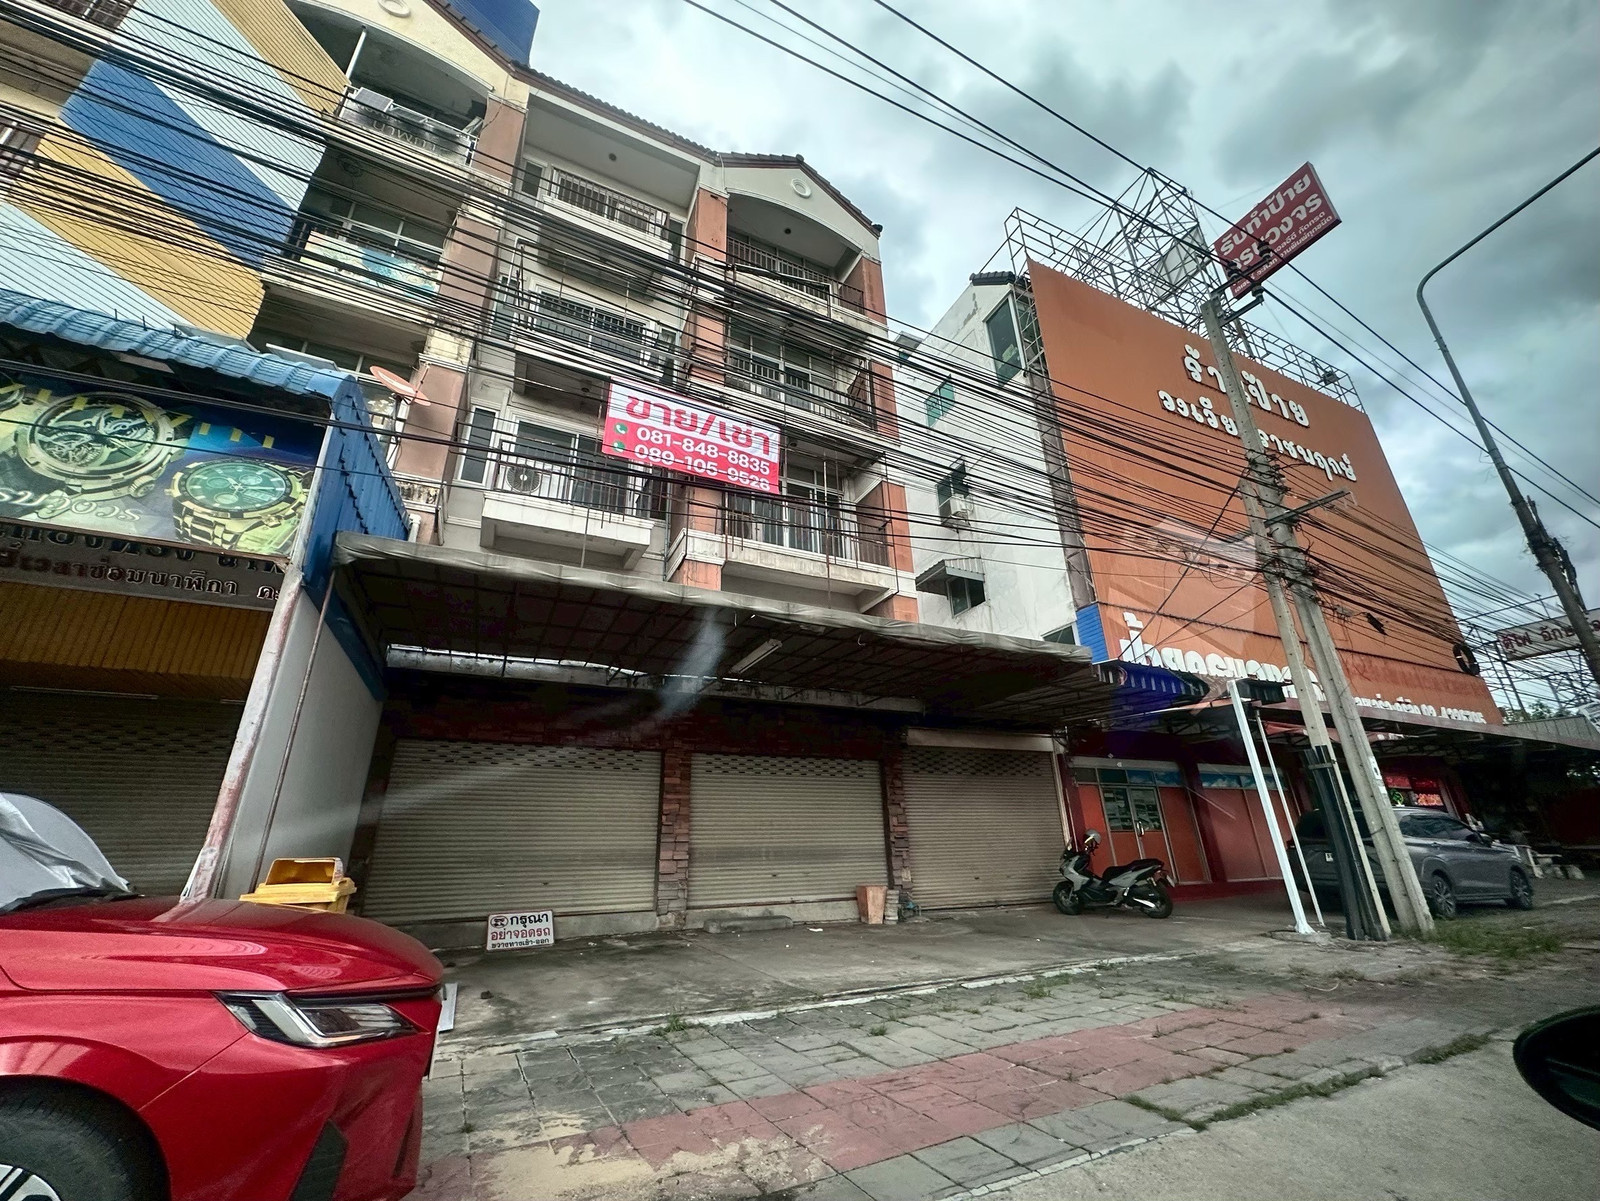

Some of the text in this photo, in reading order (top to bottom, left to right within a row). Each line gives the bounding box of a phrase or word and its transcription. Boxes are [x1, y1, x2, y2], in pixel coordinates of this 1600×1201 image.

[1220, 174, 1311, 256] รับทำป้าย
[1184, 344, 1309, 427] ร้าป้าย
[625, 395, 770, 456] ขาย/เช่า
[636, 427, 770, 475] 081-848-8835
[1158, 390, 1357, 482] วงเวียราชพฤกษ์
[634, 444, 771, 492] 089-105-9528
[491, 927, 551, 941] อย่าจอดรถ
[510, 913, 549, 928] กรุณา
